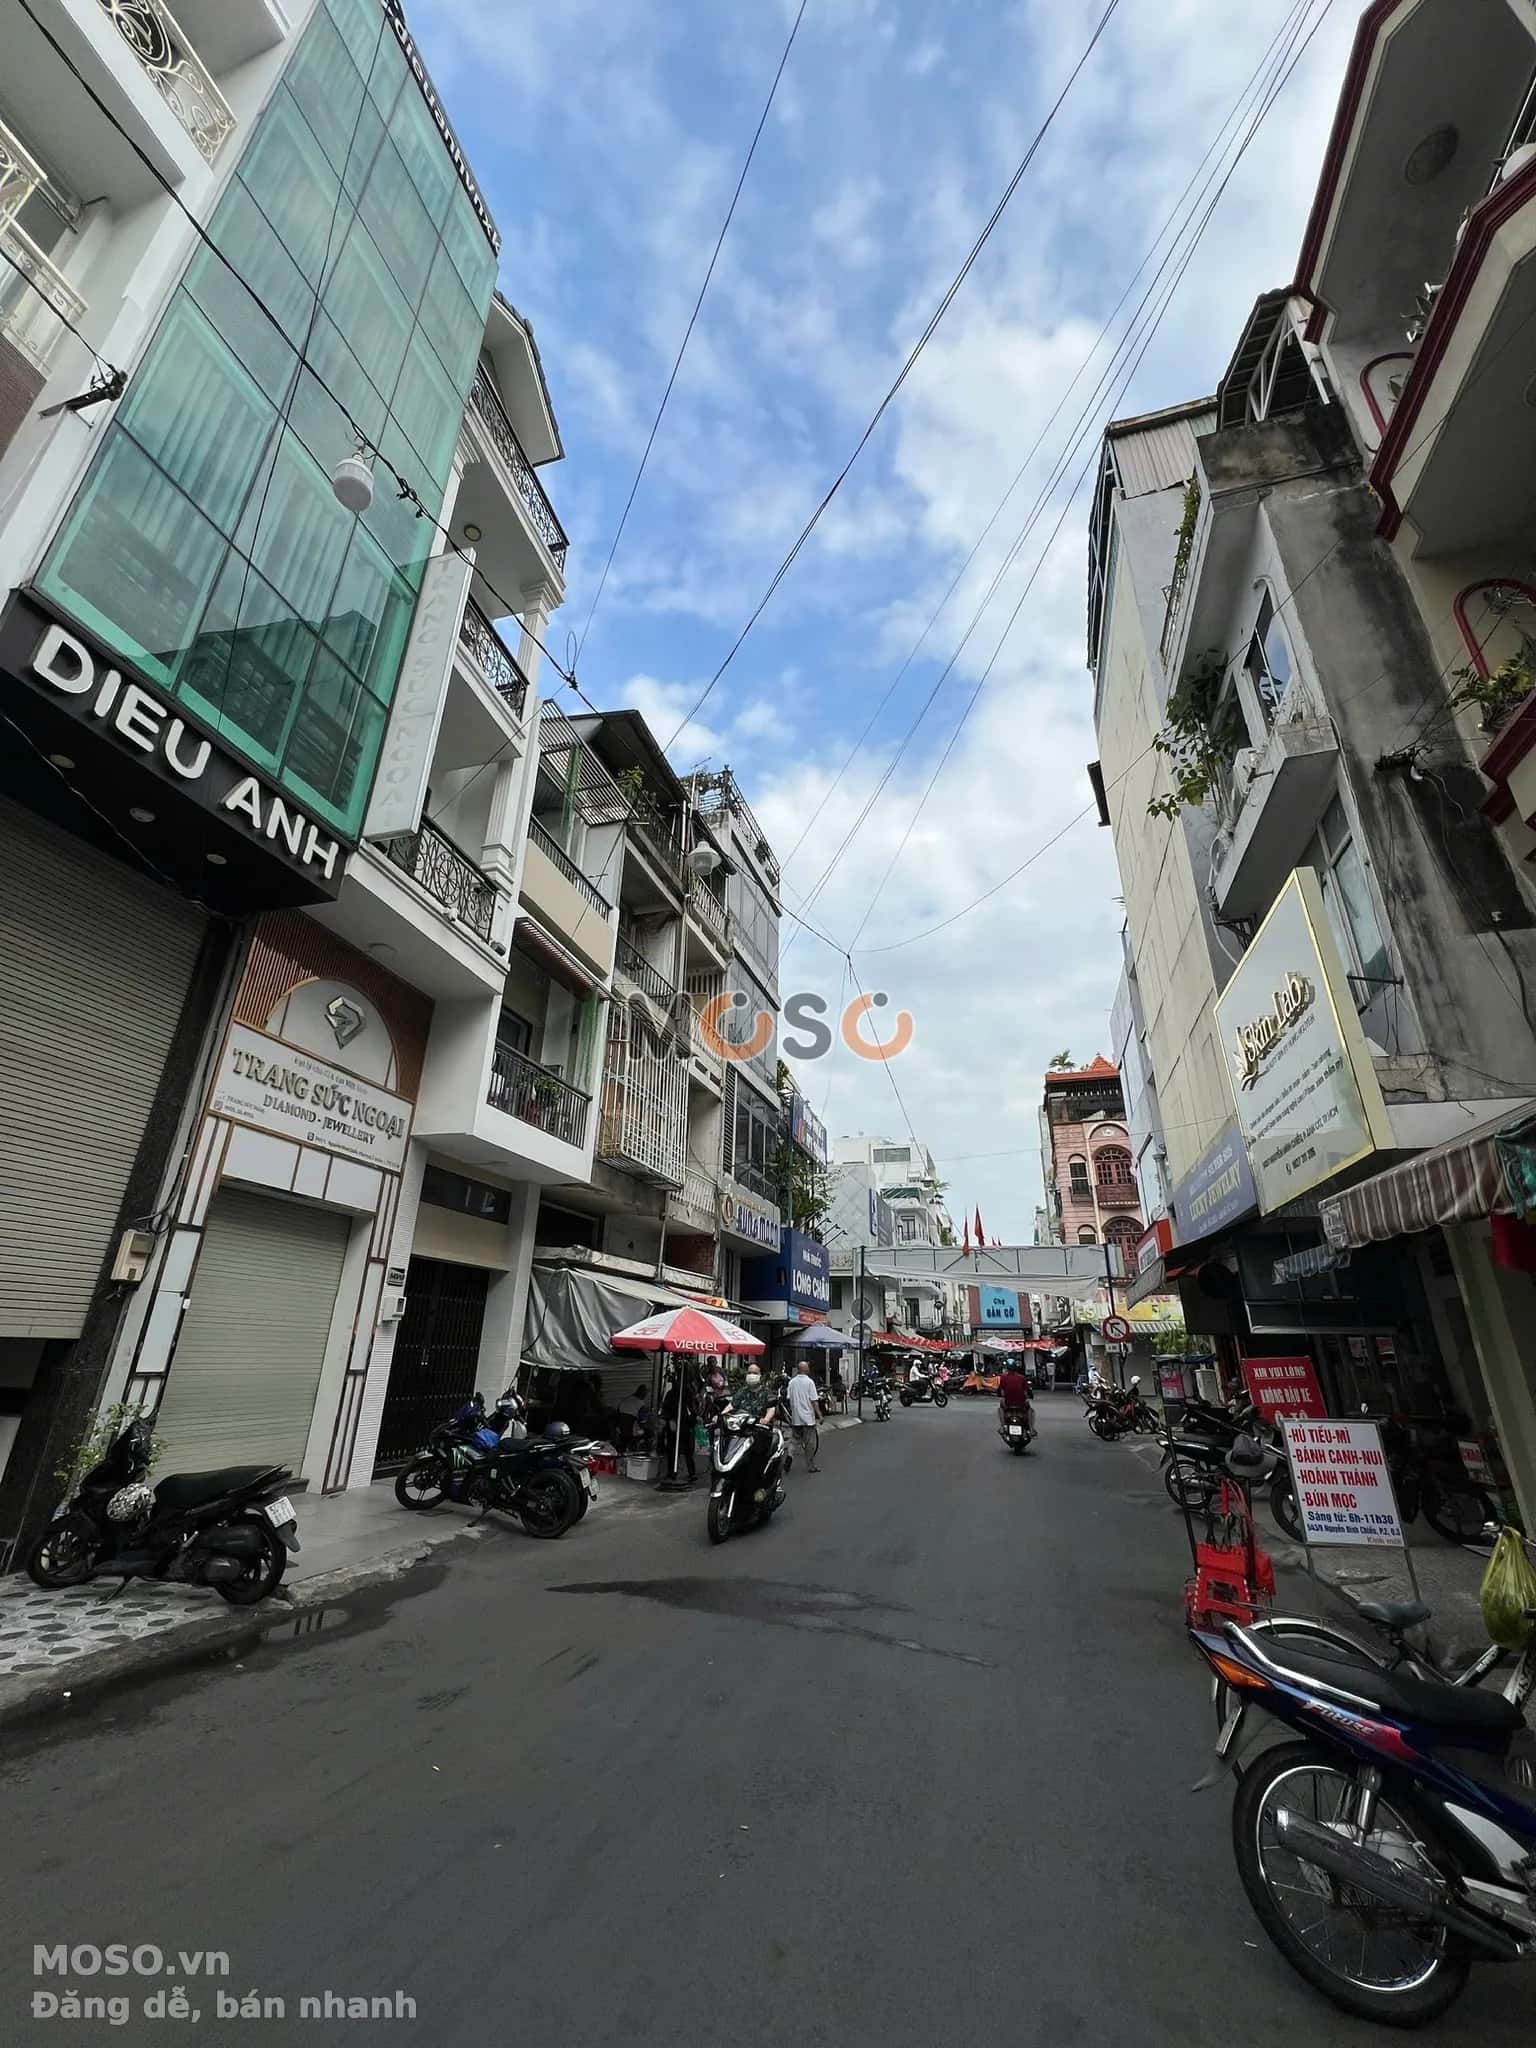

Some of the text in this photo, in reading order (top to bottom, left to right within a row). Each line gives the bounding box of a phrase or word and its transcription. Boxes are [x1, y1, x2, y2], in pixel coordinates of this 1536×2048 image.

[32, 623, 339, 880] DIEU ANH
[232, 1048, 309, 1100] TRANG
[311, 1083, 350, 1117] SỨC
[352, 1102, 406, 1140] NGOẠI
[263, 1094, 317, 1123] DIAMOND
[322, 1116, 376, 1145] JEWELLERY
[792, 1268, 812, 1296] LONG
[672, 1338, 718, 1352] viettel
[1253, 1365, 1306, 1378] XIN VUI LÒNG
[1258, 1386, 1285, 1404] KHÔNG
[1300, 1387, 1313, 1403] XE
[1331, 1491, 1358, 1512] MỌC
[1307, 1510, 1332, 1523] Sáng
